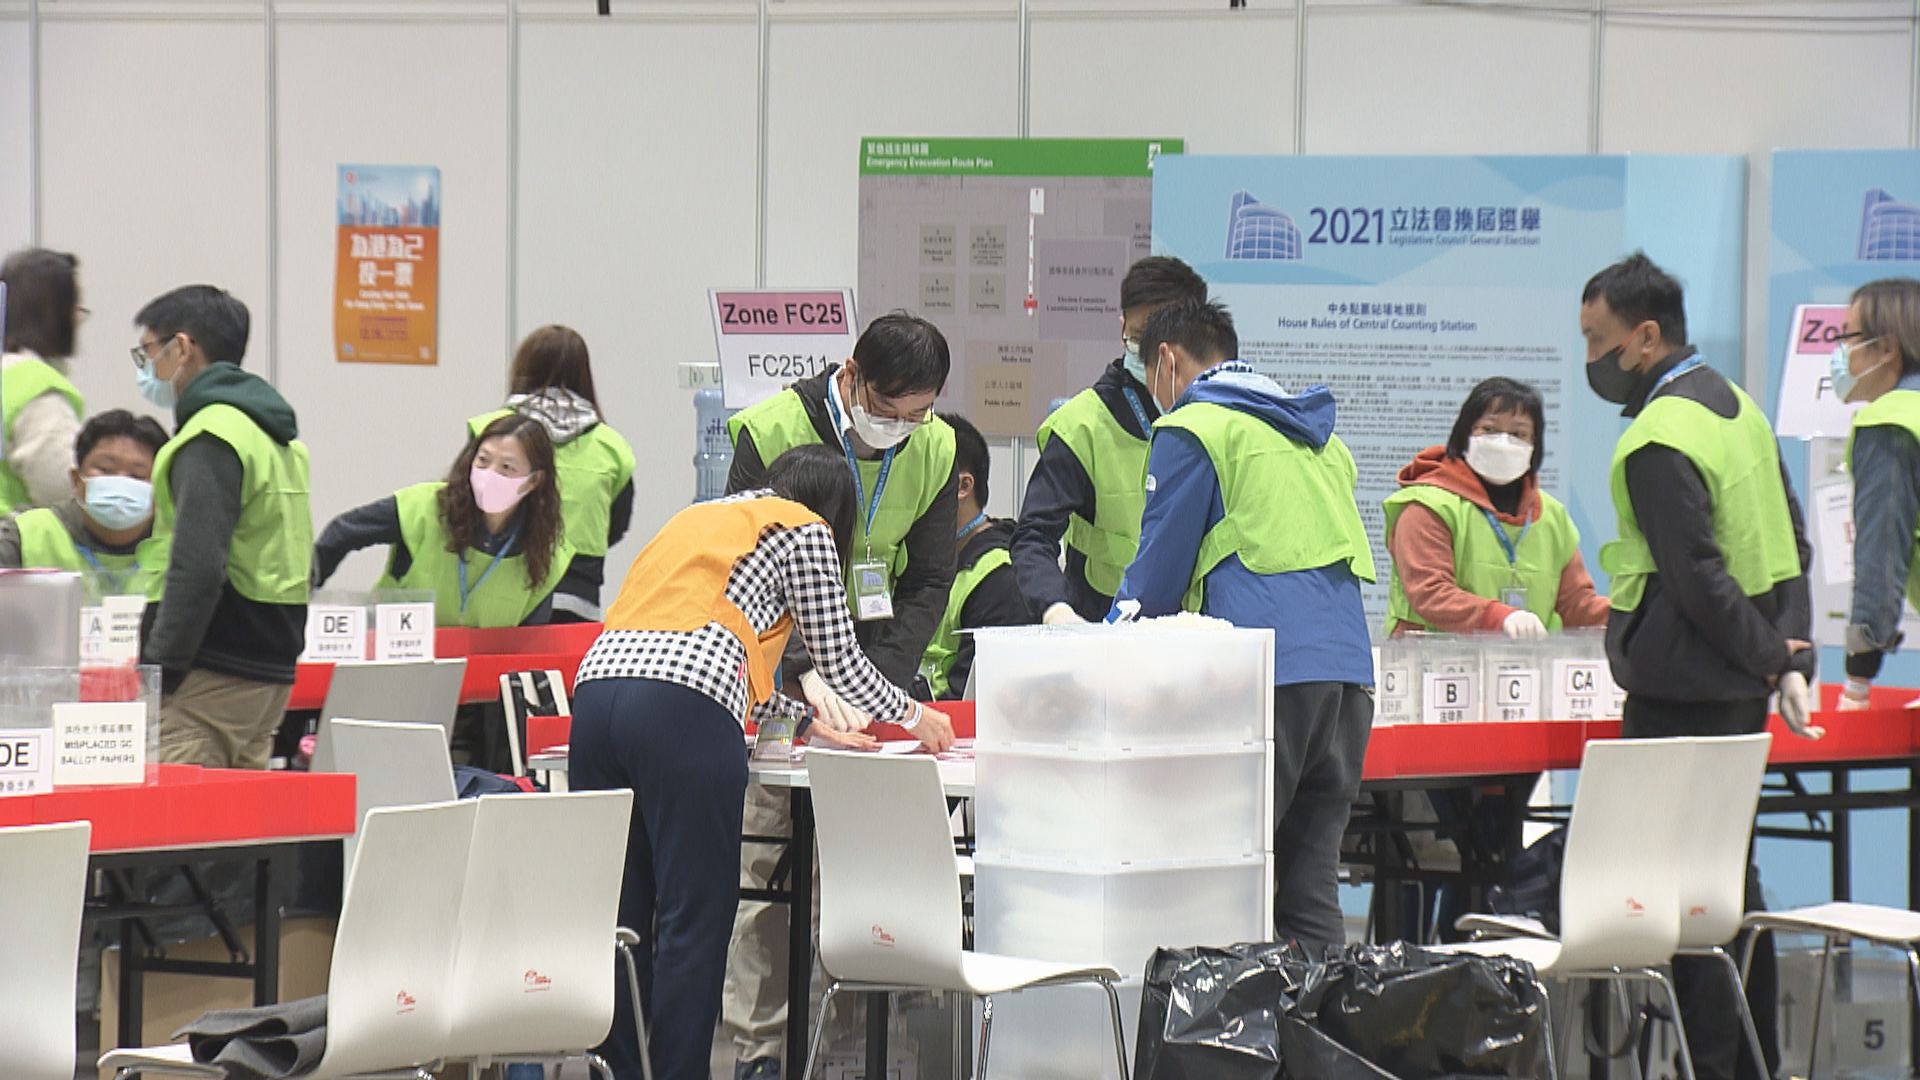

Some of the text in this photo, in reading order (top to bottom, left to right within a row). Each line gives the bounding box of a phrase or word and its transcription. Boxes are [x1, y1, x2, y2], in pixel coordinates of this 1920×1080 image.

[867, 156, 993, 169] Emergency Evacuation Route Plan
[1308, 207, 1384, 244] 2021
[1389, 234, 1540, 246] Legislative Council General Election
[723, 303, 842, 324] Zone FC25
[1278, 317, 1477, 332] House Rules of Central Counting Station
[748, 354, 827, 377] FC2511
[324, 616, 348, 633] DE
[400, 612, 412, 631] K
[1386, 672, 1395, 692] C
[1509, 680, 1520, 699] C
[1572, 670, 1594, 691] CA
[1446, 683, 1457, 703] B
[64, 740, 117, 749] MISPLACED
[0, 743, 29, 767] DE
[61, 754, 135, 765] BALLOT PAPERS
[1864, 1019, 1885, 1050] 5
